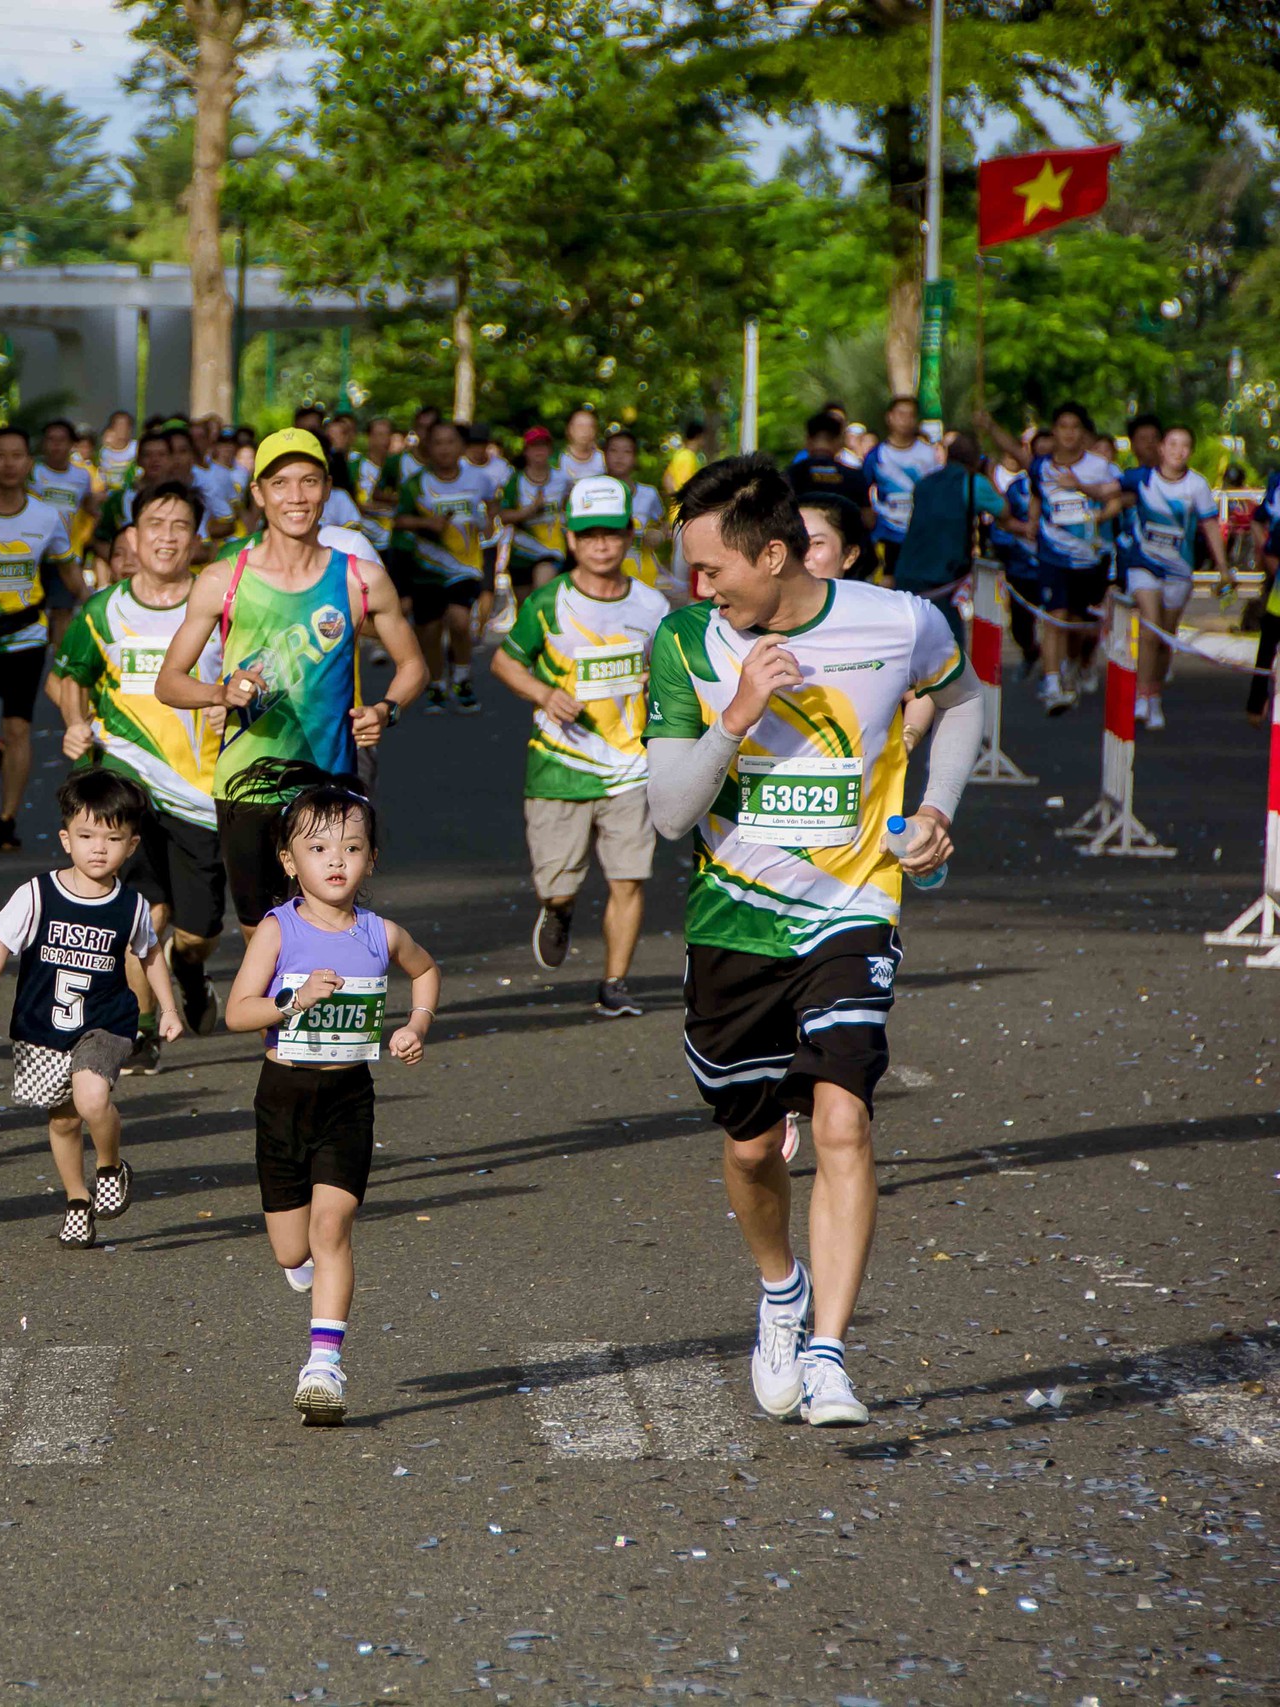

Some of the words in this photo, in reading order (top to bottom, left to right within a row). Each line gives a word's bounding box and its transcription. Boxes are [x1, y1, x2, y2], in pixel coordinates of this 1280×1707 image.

[135, 654, 164, 672] 532
[761, 785, 838, 812] 53629
[48, 921, 116, 953] FISRT
[51, 968, 92, 1031] 5
[308, 1003, 368, 1028] 53175
